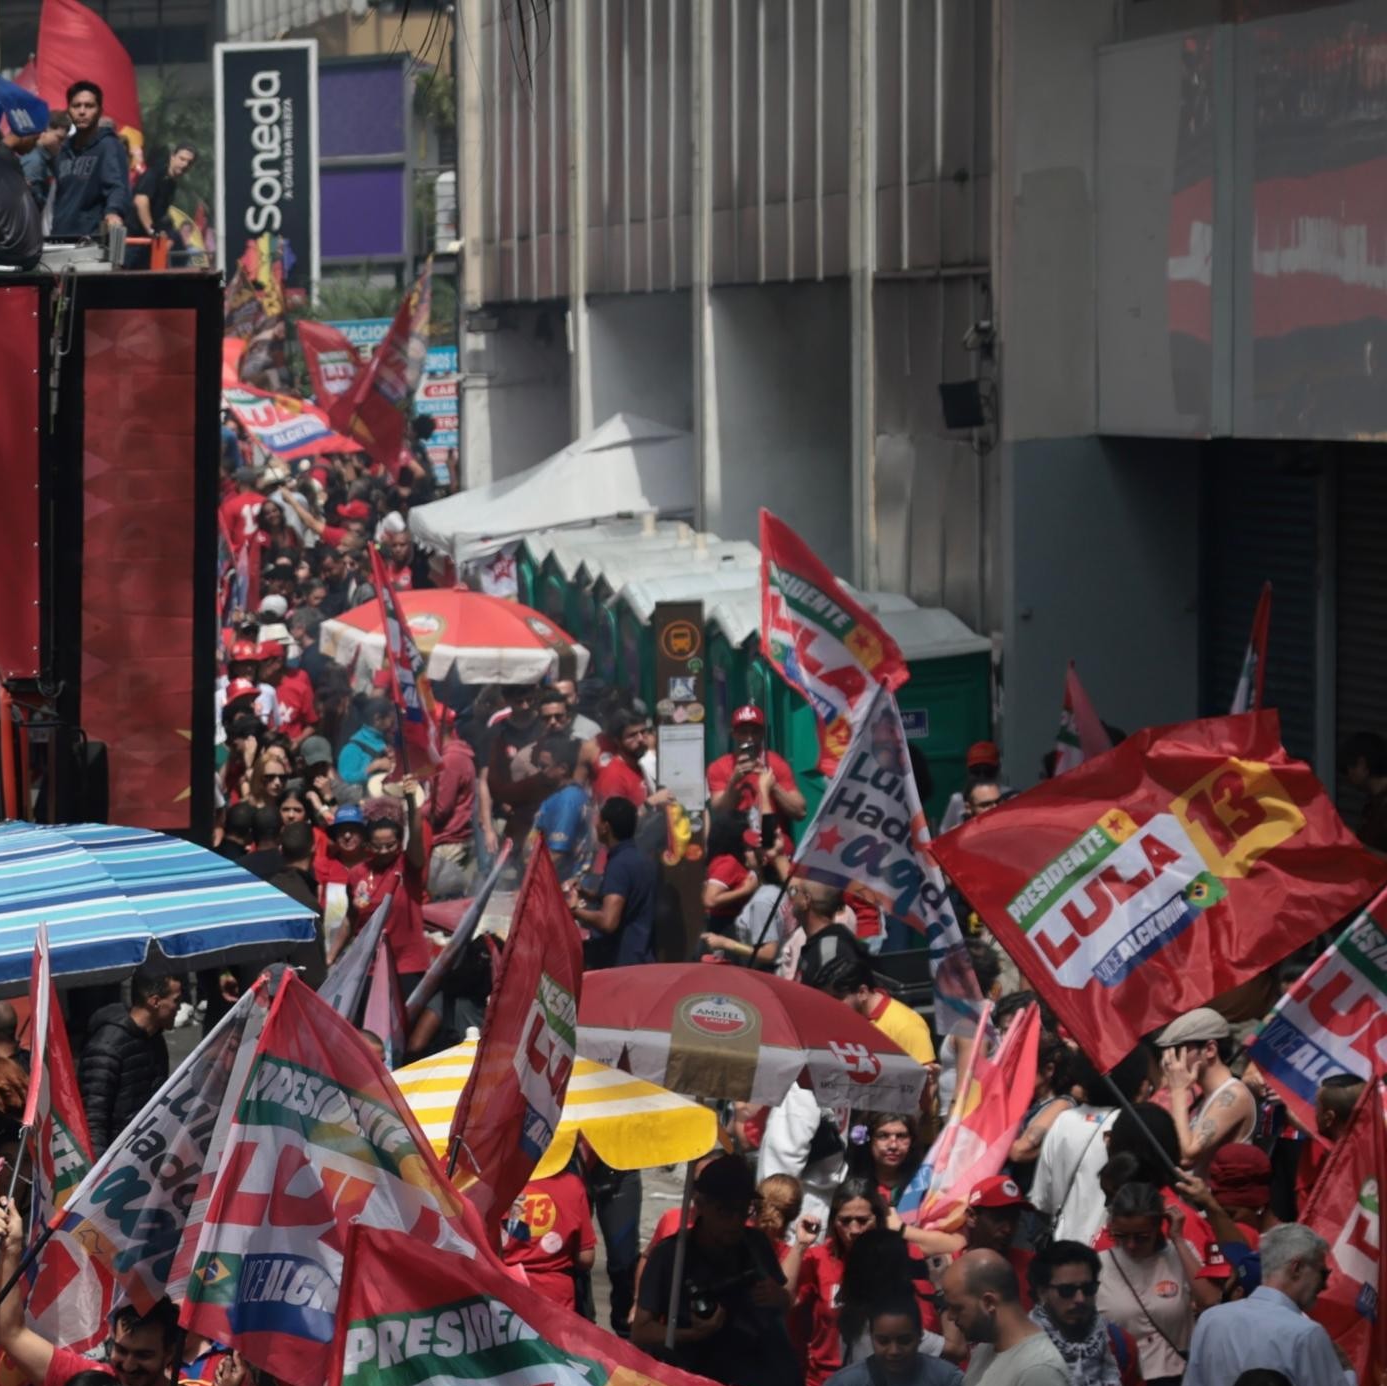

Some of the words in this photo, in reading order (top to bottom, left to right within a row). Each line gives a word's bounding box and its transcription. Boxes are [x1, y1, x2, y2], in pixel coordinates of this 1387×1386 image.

[245, 69, 282, 232] Soneda
[1185, 768, 1269, 855] 13
[1006, 825, 1108, 924] PRESIDENTE
[1033, 834, 1182, 970] LULA
[1117, 894, 1189, 968] ALCKMIN
[697, 1008, 740, 1020] AMSTEL
[523, 1198, 551, 1227] 13
